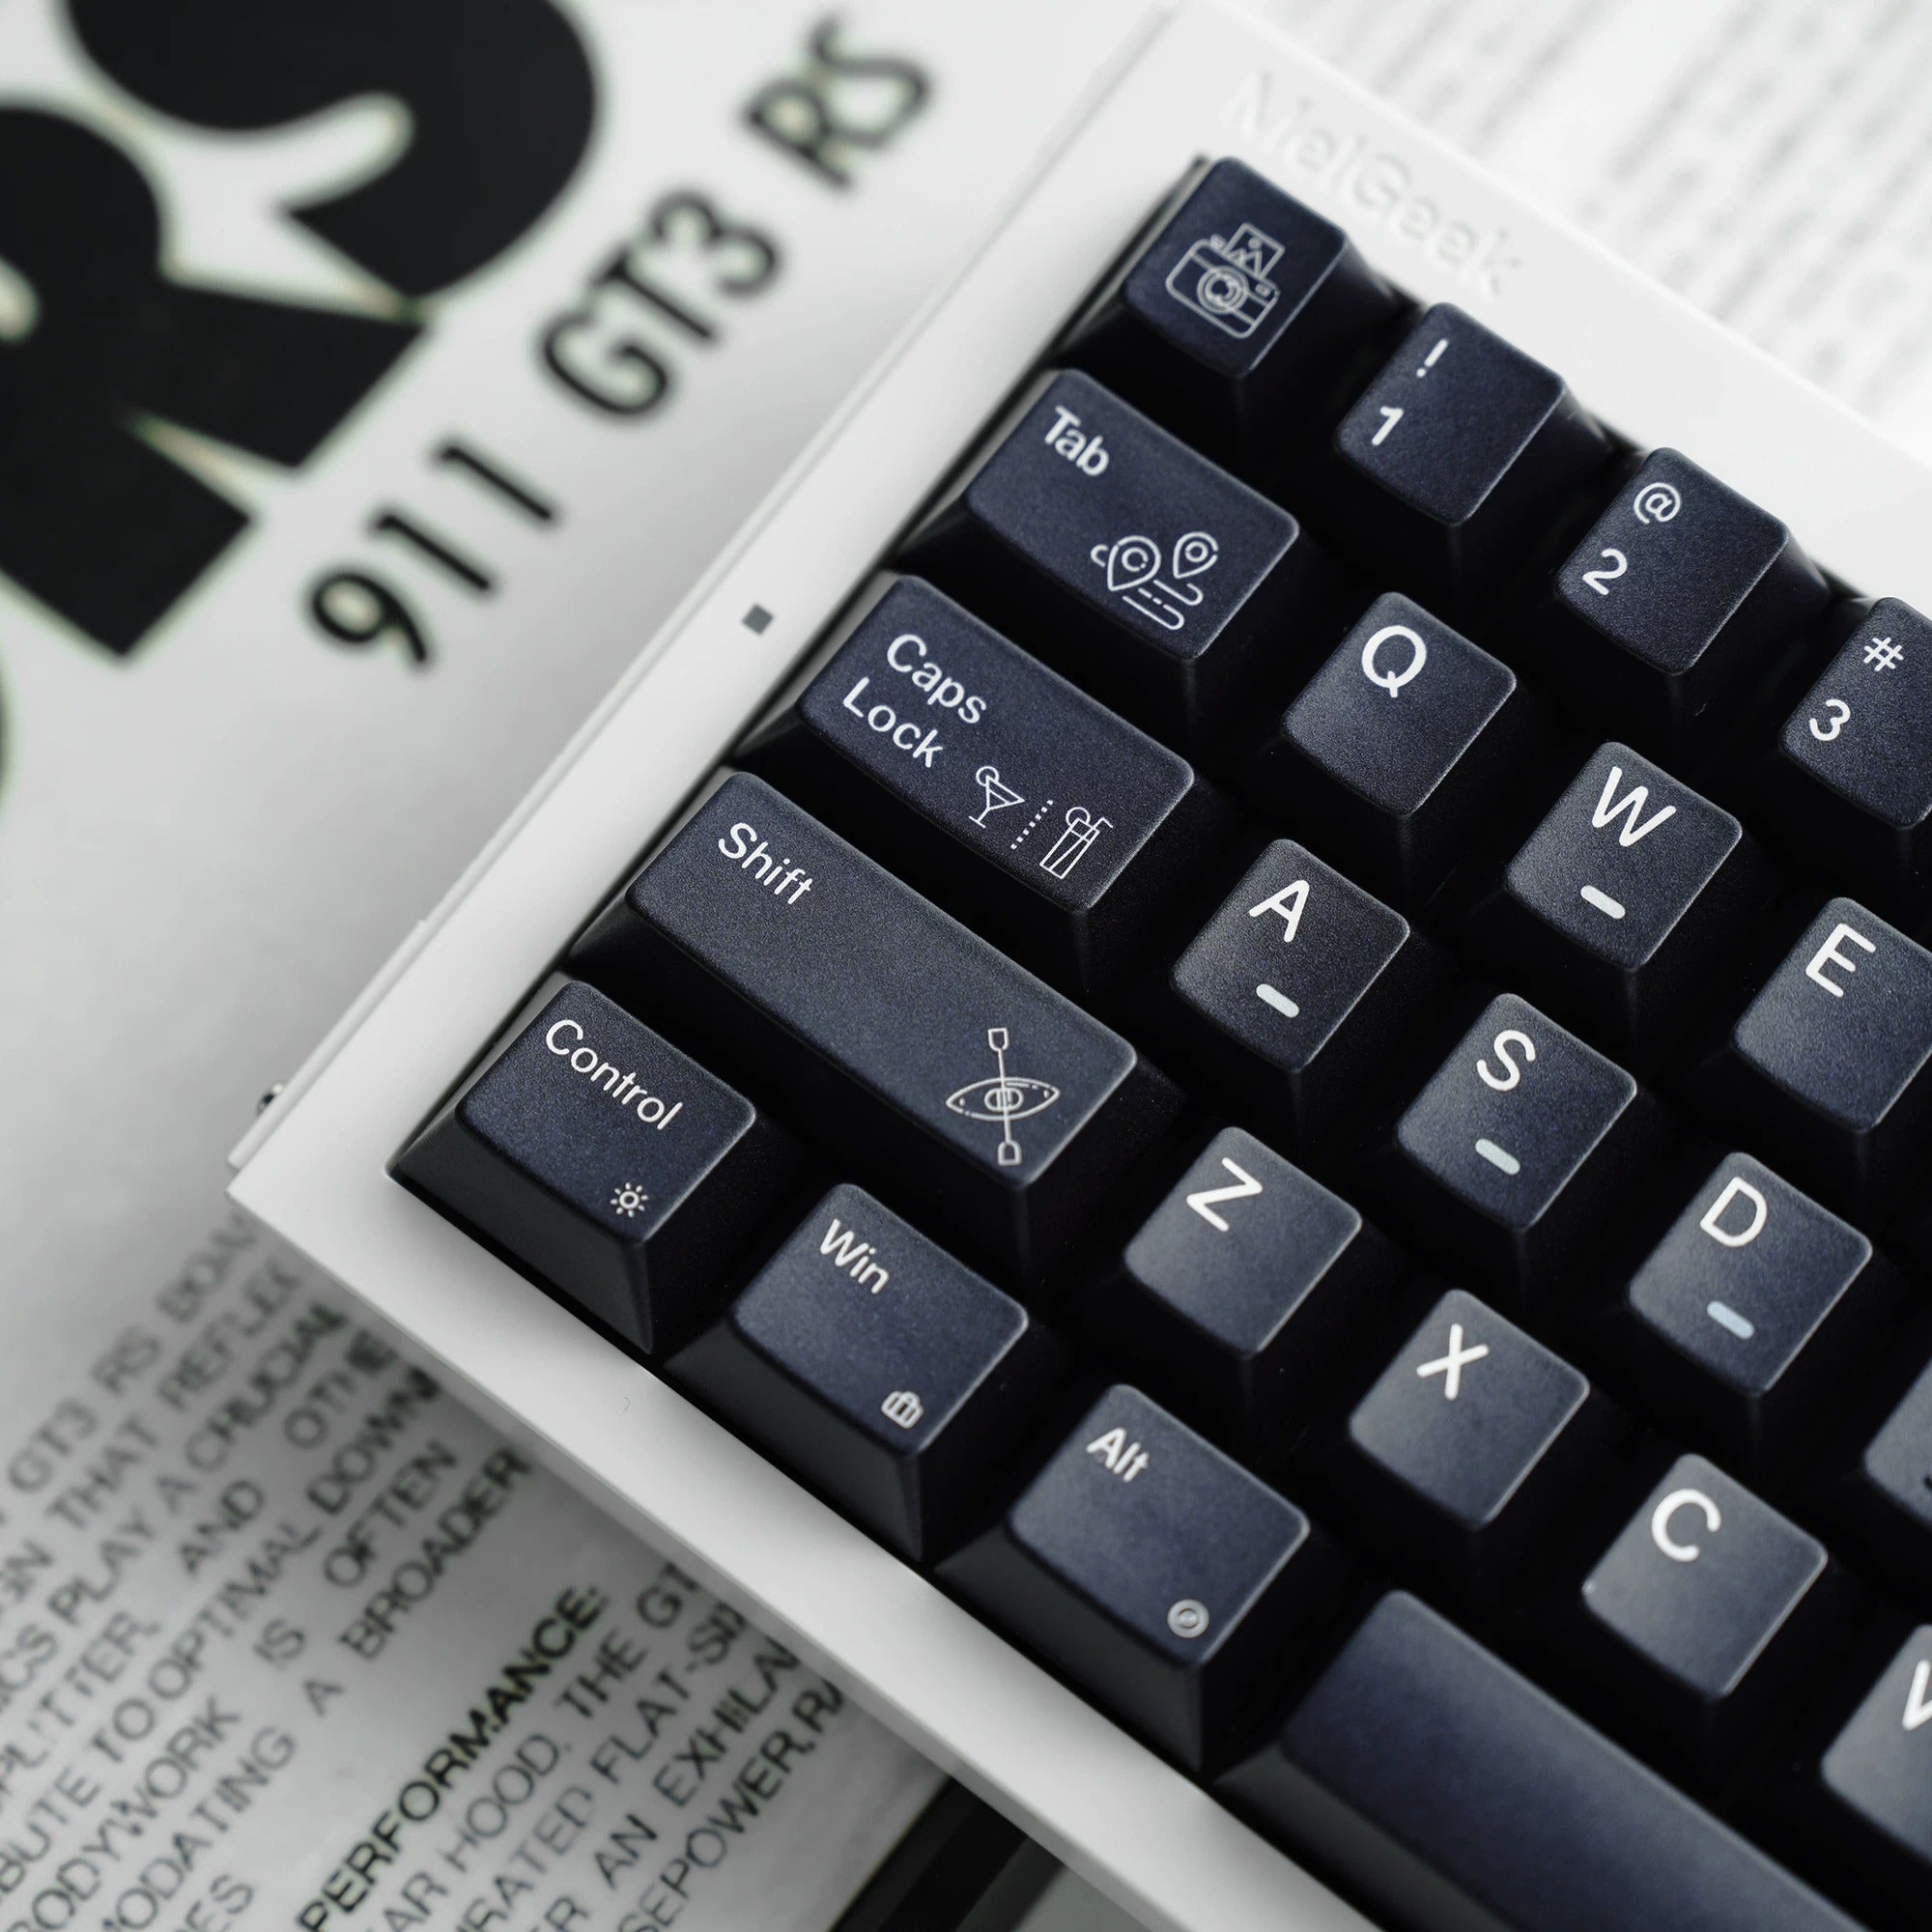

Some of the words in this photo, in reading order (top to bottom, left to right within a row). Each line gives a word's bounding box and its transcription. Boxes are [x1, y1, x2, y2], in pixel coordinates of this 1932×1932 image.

[305, 434, 562, 669] 911
[535, 184, 786, 423] GT3
[741, 15, 935, 190] RS
[1415, 339, 1448, 378] !
[1043, 406, 1110, 477] Tab
[1371, 406, 1404, 446] 1
[1633, 481, 1682, 526] @
[1581, 548, 1629, 596] 2
[886, 633, 987, 724] Caps
[1361, 624, 1428, 698] Q
[1862, 637, 1904, 672] #
[842, 675, 944, 769] Lock
[1808, 698, 1852, 742] 3
[1591, 765, 1677, 848] W
[718, 822, 814, 906] Shift
[1247, 879, 1311, 943] A
[1804, 923, 1876, 998] E
[545, 1018, 683, 1130] Control
[1476, 1029, 1536, 1092] S
[1186, 1156, 1263, 1233] Z
[1699, 1176, 1768, 1247] D
[819, 1218, 890, 1294] Win
[1416, 1323, 1490, 1400] X
[1086, 1427, 1149, 1483] Alt
[178, 1476, 264, 1575] AND
[1651, 1489, 1721, 1562] C
[46, 1505, 156, 1628] PLAY
[8, 1694, 241, 1932] ODYWORK
[253, 1616, 307, 1671] IS
[324, 1438, 459, 1589] OFTEN
[101, 1724, 298, 1932] ODATING
[300, 1679, 345, 1719] A
[337, 1445, 533, 1661] BROADER
[552, 1629, 650, 1720] THE
[89, 1696, 155, 1764] TO
[295, 1584, 610, 1932] PERFORMANCE:
[593, 1811, 660, 1891] AN
[651, 1634, 802, 1808] EXHILA
[455, 1785, 596, 1932] RATED
